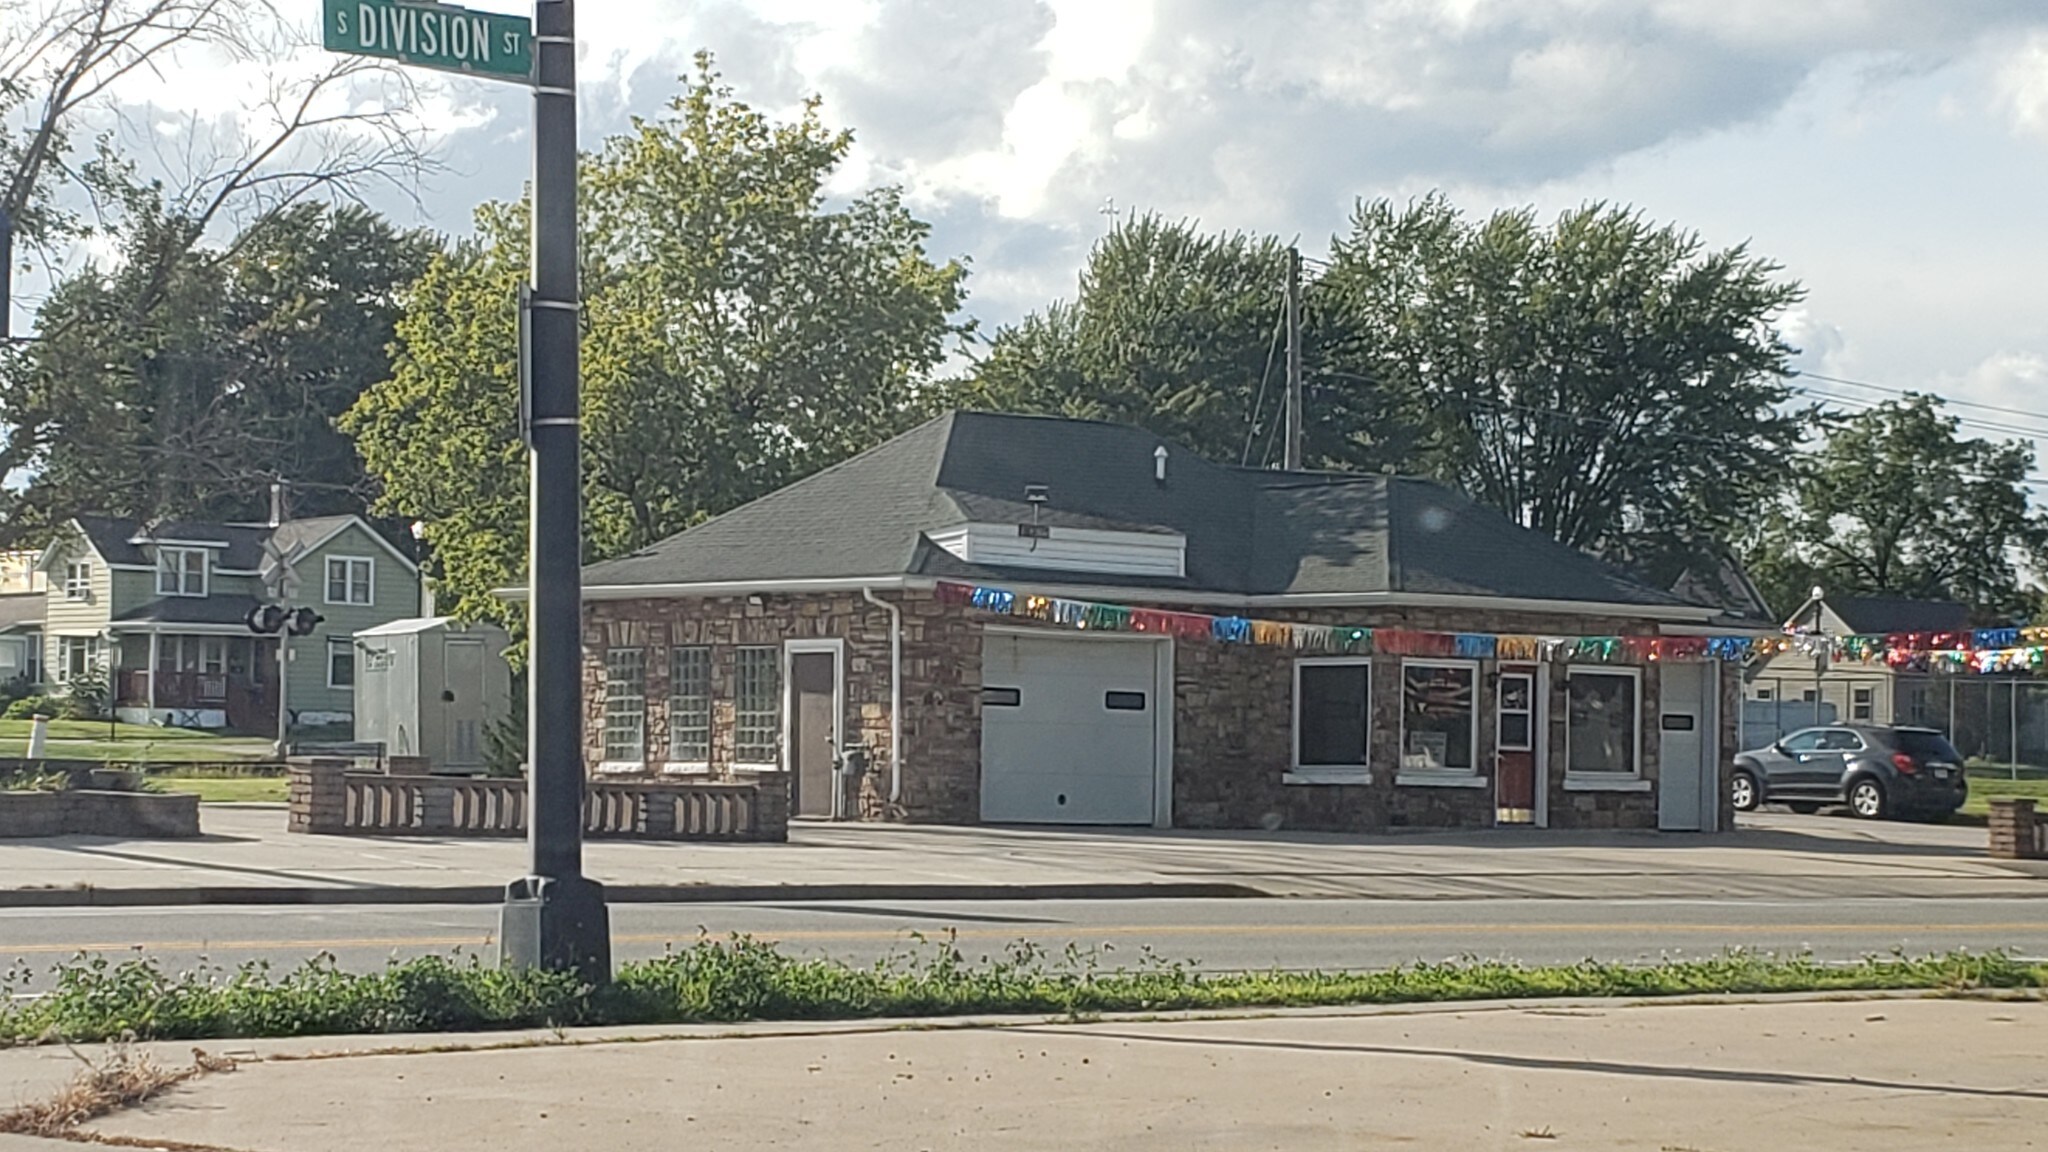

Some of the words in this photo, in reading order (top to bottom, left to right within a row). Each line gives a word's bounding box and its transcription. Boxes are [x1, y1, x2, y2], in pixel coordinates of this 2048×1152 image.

[337, 11, 348, 35] S
[358, 3, 490, 62] DIVISION
[503, 32, 520, 56] ST
